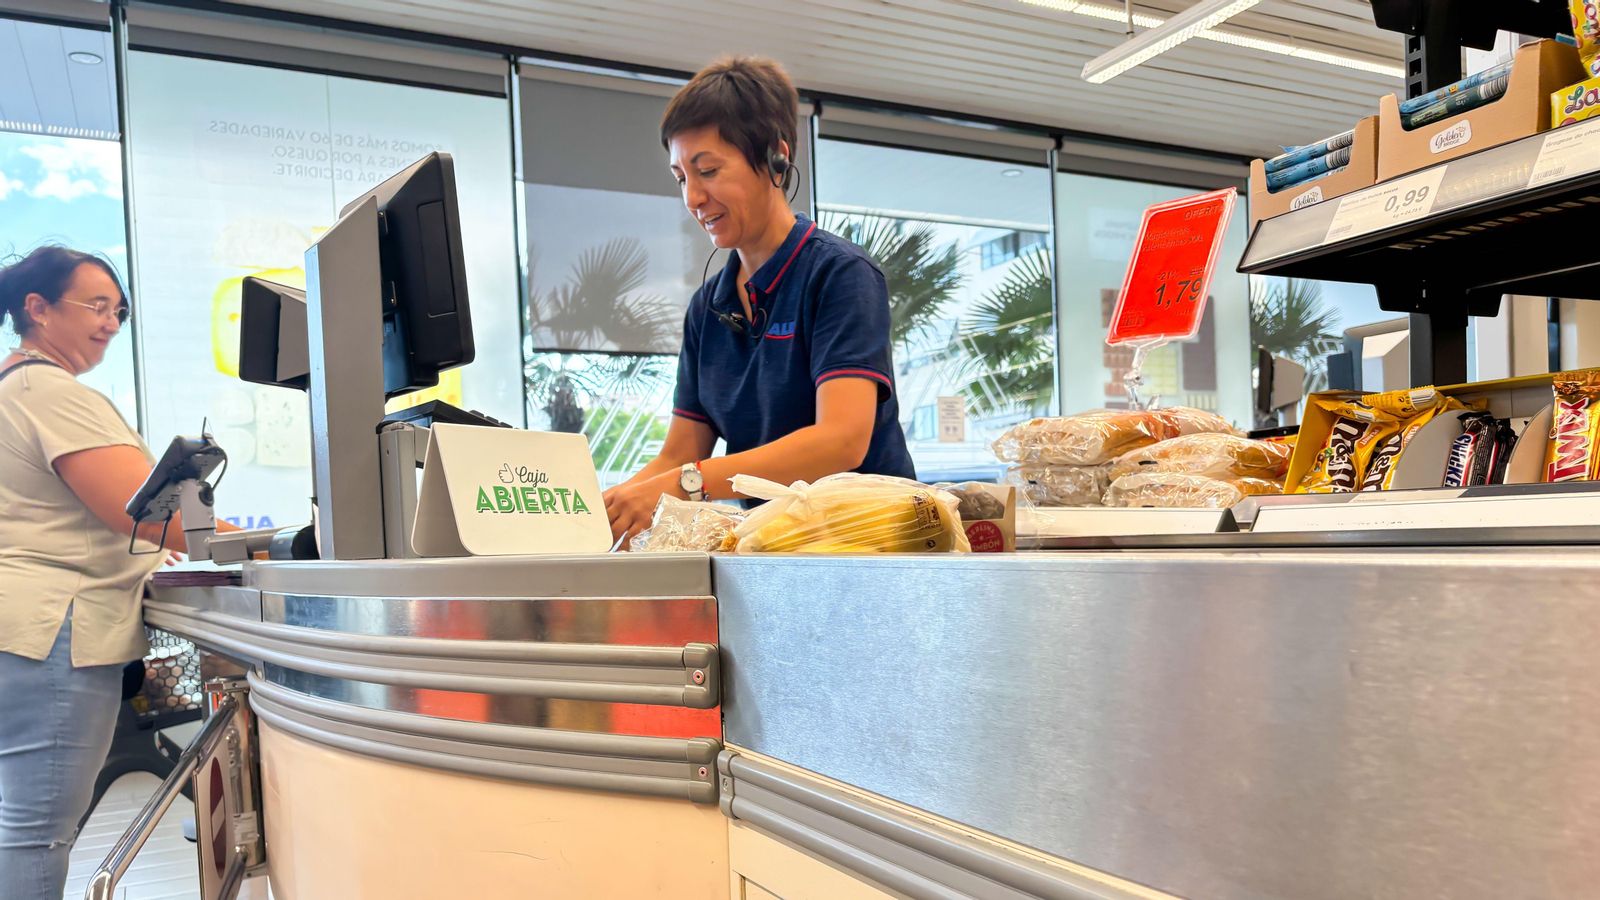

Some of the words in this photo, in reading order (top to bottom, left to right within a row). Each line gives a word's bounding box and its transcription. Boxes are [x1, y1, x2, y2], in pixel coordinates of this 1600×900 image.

[1384, 186, 1430, 212] 0,99
[1155, 277, 1203, 308] 1,79
[1547, 397, 1589, 482] TWIX
[1445, 434, 1473, 487] SNICKE
[515, 466, 549, 487] Caja
[476, 485, 592, 514] ABIERTA
[971, 539, 1000, 552] OMBÓN
